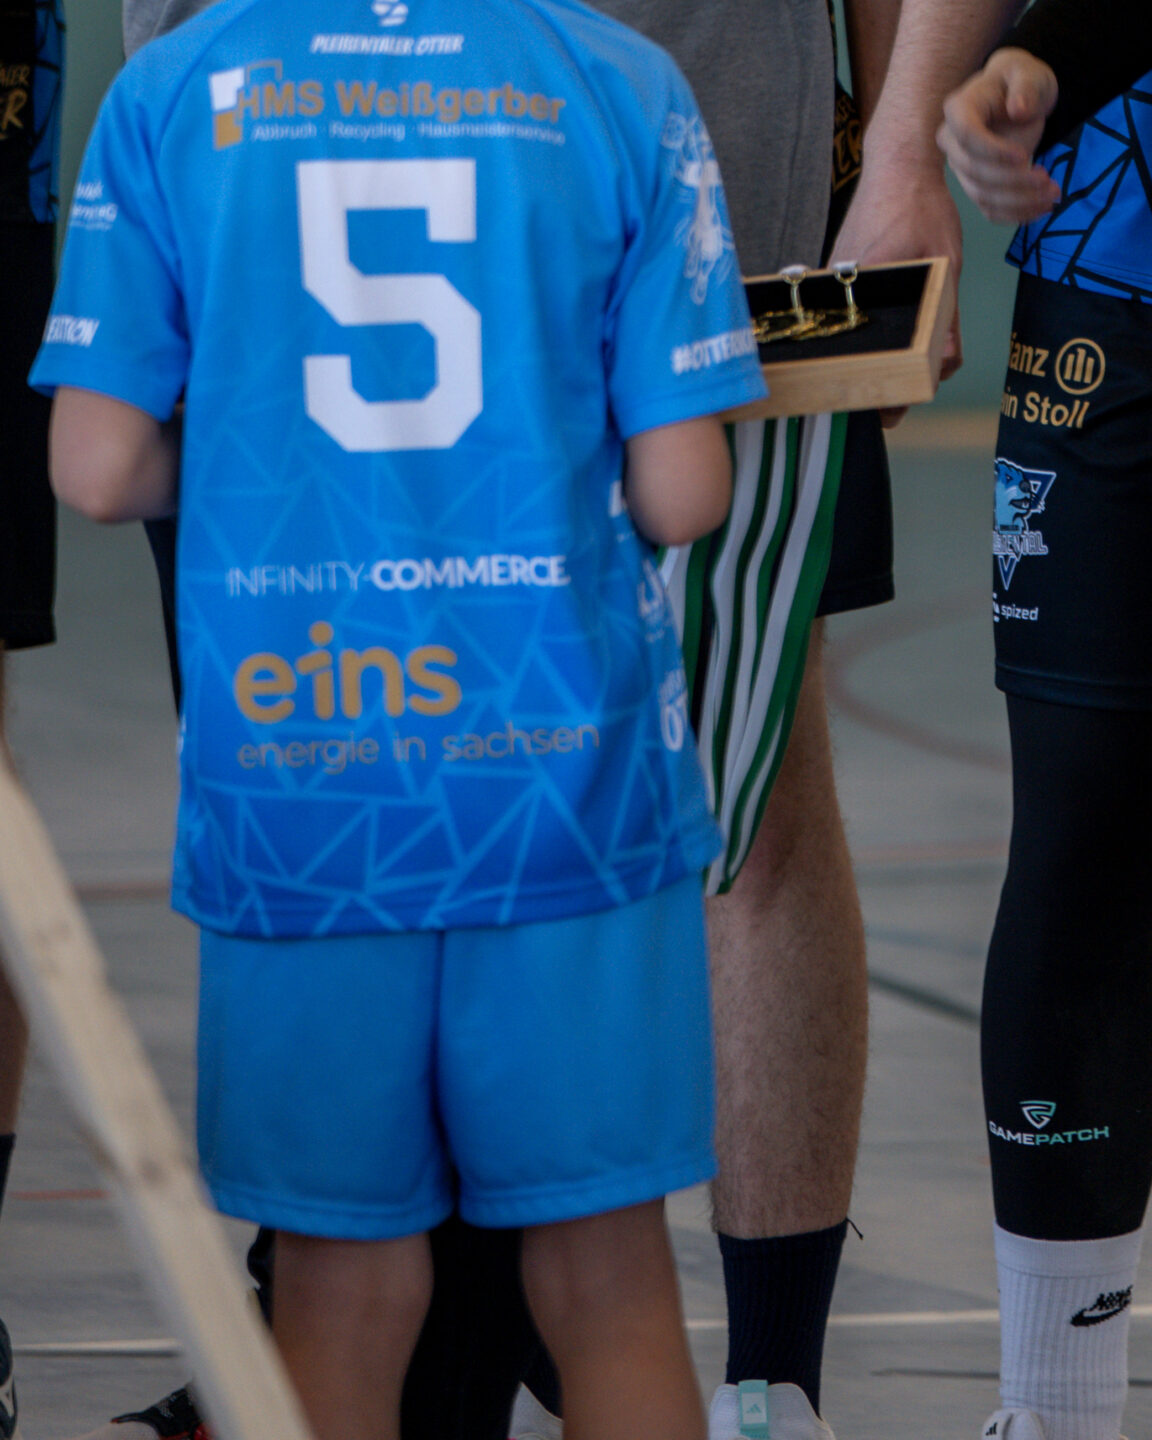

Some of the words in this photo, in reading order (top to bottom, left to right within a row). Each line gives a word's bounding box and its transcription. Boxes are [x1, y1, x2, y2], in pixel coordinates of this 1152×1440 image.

[238, 80, 325, 120] HMS
[335, 80, 567, 125] Weißgerber
[294, 158, 485, 454] 5
[1010, 334, 1050, 378] ianz
[1022, 391, 1090, 429] Stoll
[1001, 604, 1039, 621] spized
[233, 620, 463, 725] eins
[237, 730, 381, 775] energie
[393, 731, 427, 764] in
[442, 719, 601, 761] sachsen
[989, 1120, 1110, 1146] GAMEPATCH
